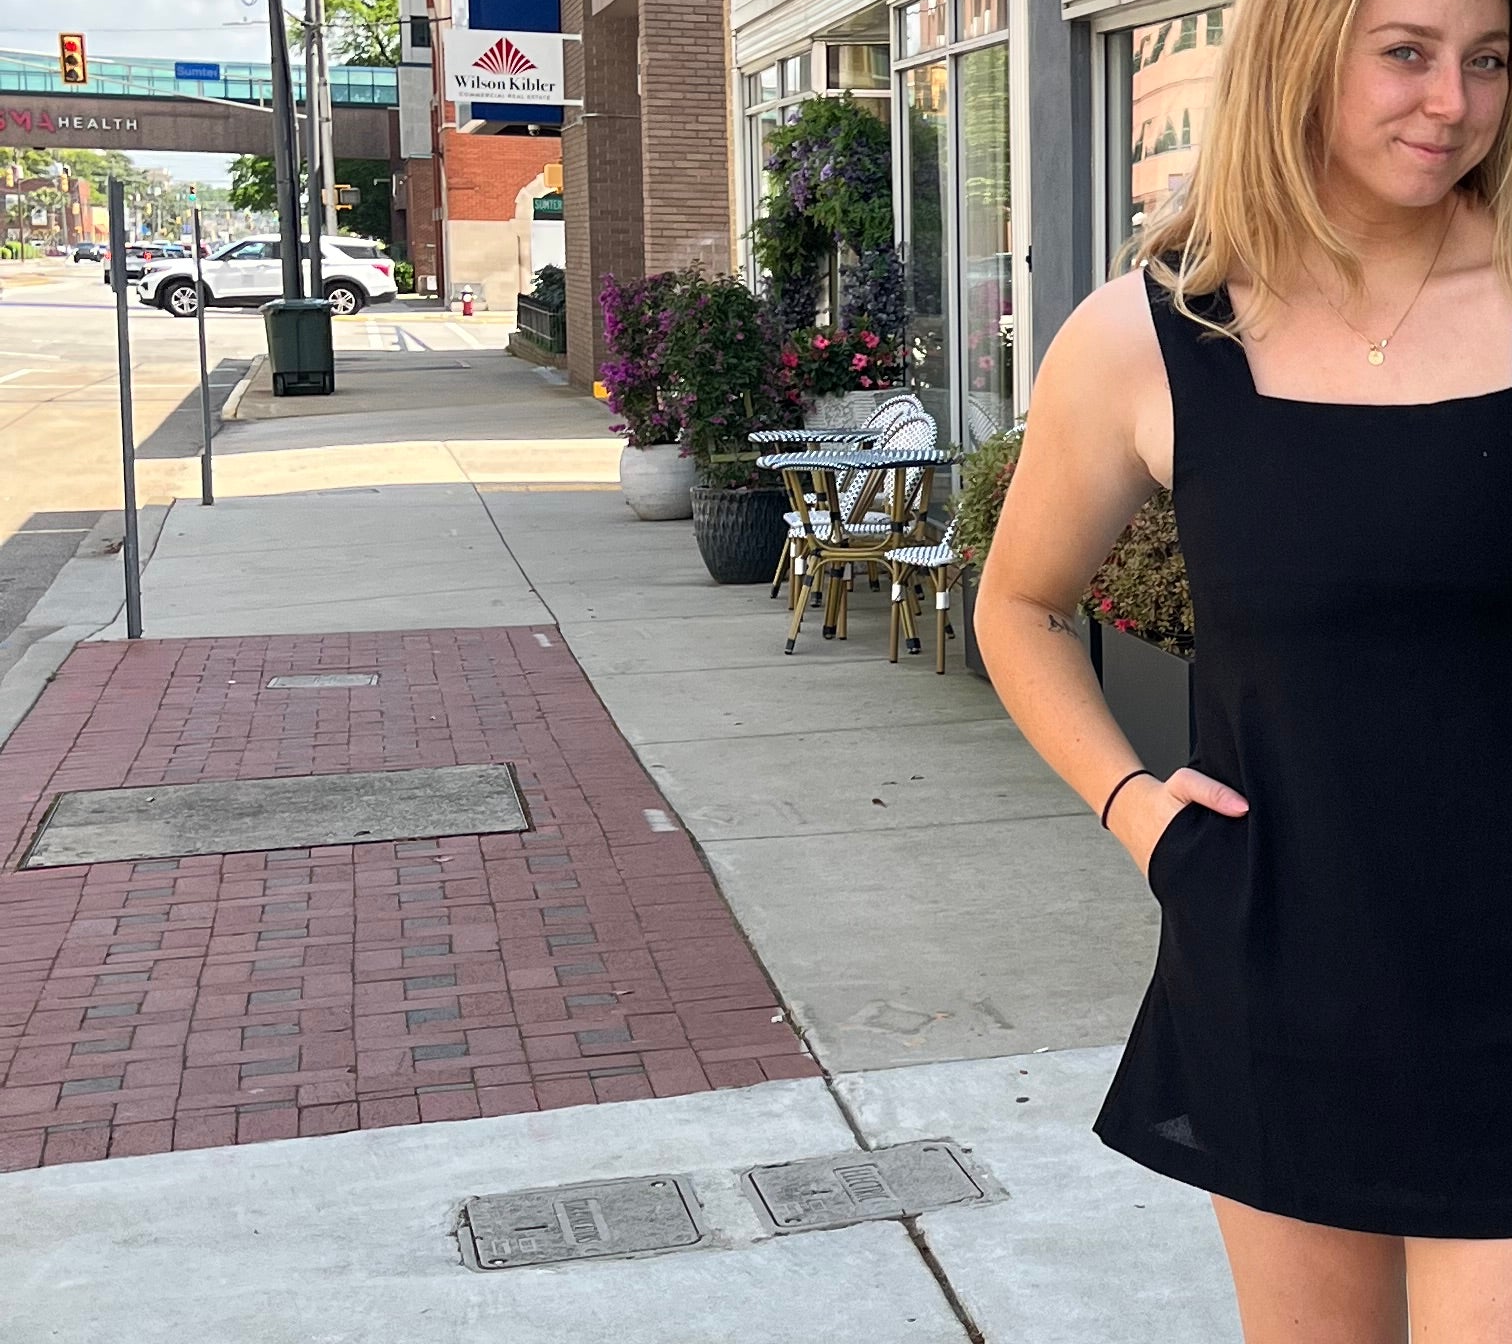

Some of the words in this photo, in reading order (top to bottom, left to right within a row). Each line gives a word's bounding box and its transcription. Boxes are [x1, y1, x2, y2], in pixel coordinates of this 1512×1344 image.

[176, 66, 218, 78] Sumter
[454, 74, 506, 90] Wilson
[509, 77, 556, 92] Kibler
[58, 116, 138, 131] HEALTH
[534, 199, 562, 210] SUMTER
